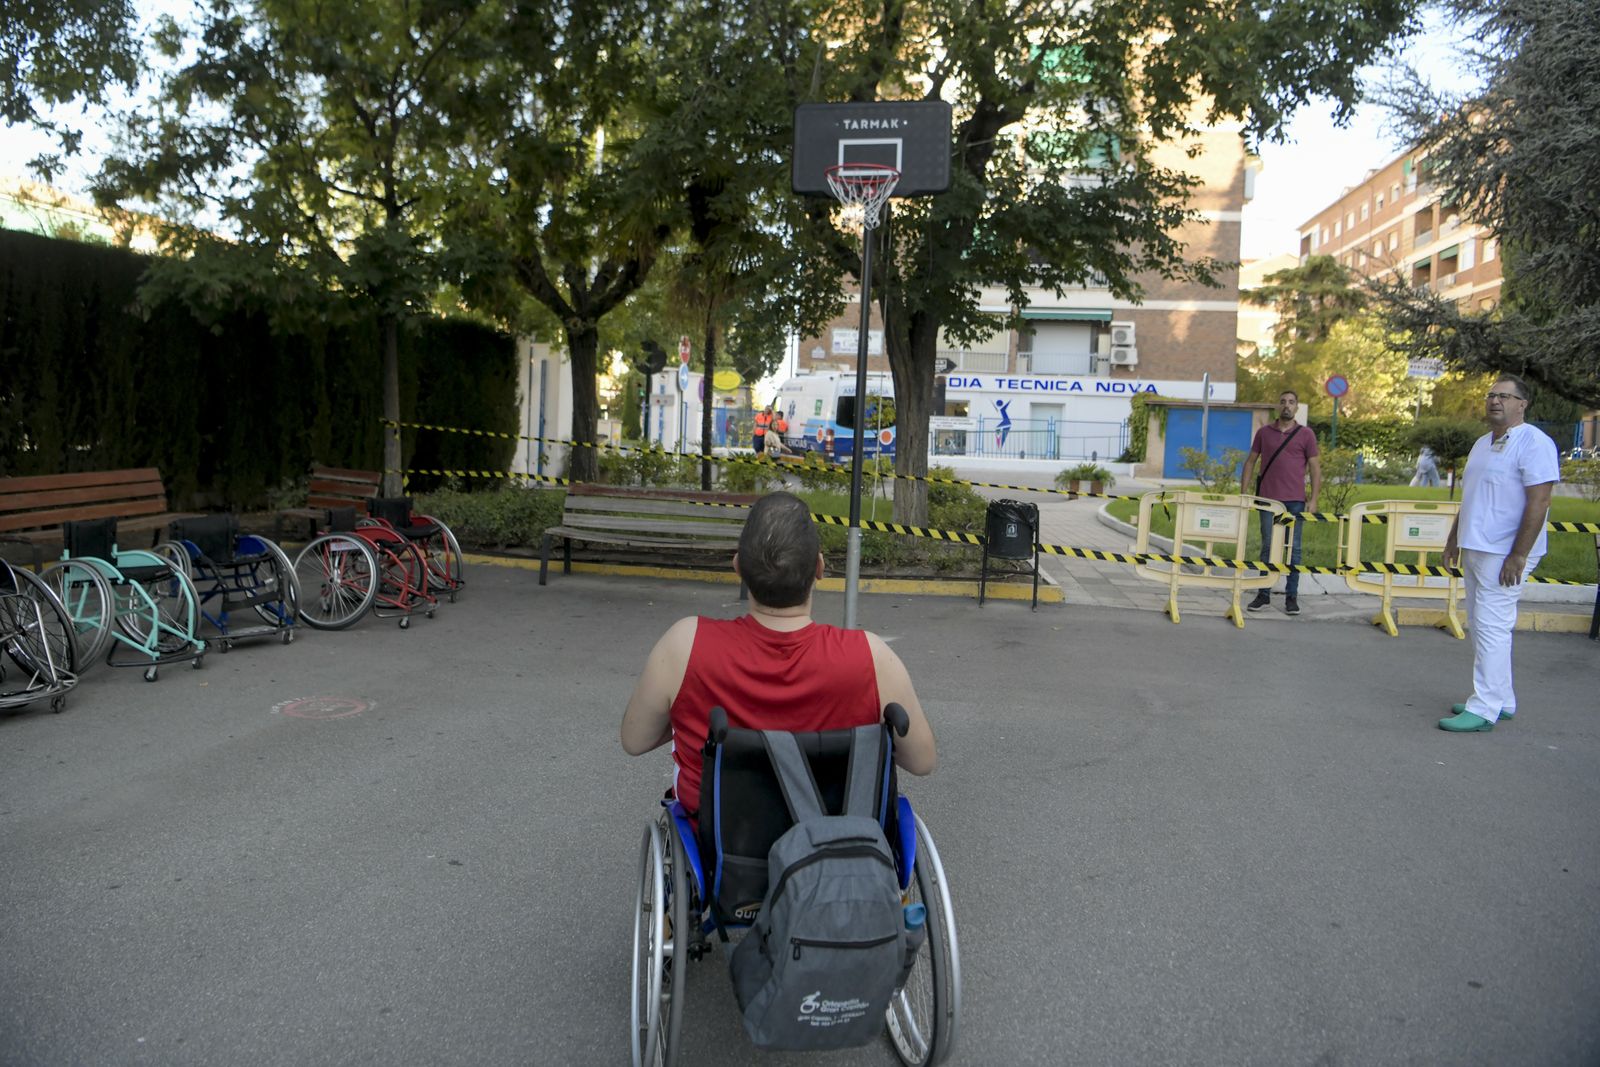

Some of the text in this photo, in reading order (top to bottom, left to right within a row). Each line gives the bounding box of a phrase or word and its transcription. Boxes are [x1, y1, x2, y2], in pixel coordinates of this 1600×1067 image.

[843, 118, 899, 130] TARMAK
[995, 378, 1083, 392] TECNICA
[1096, 382, 1158, 394] NOVA
[734, 908, 757, 920] QUI
